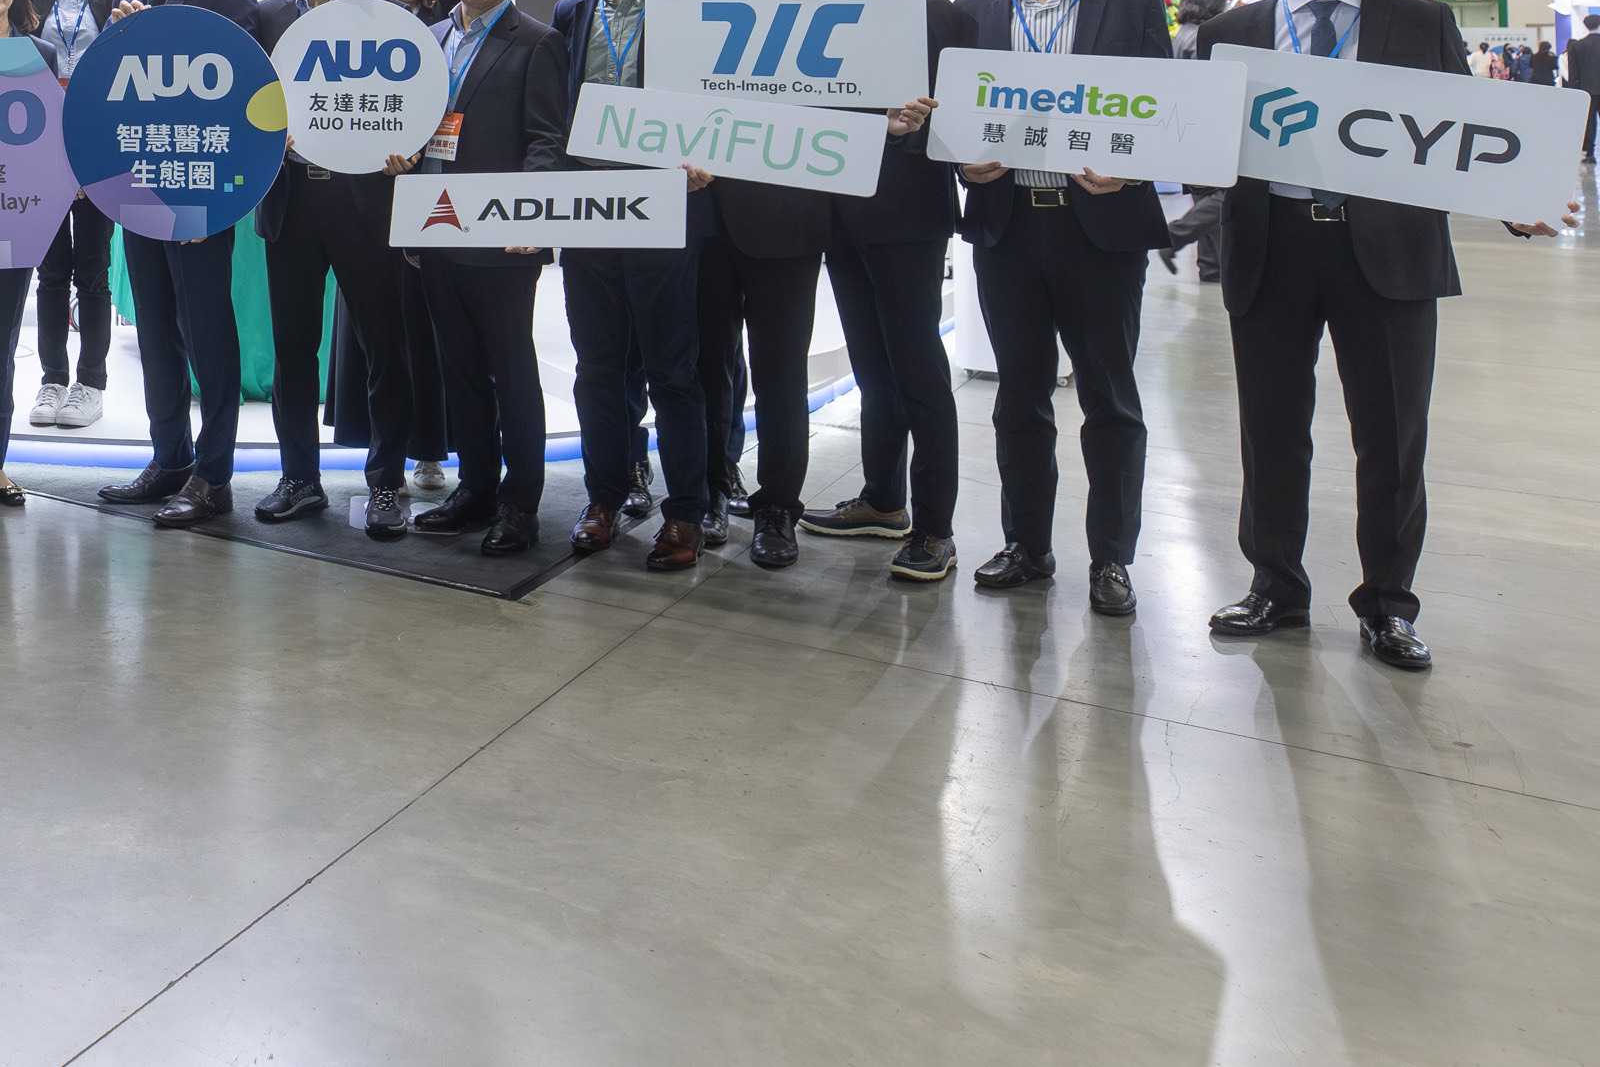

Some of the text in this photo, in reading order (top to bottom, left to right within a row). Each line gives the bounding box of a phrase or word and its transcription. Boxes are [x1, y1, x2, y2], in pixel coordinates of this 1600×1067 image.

[293, 38, 421, 82] AUO
[106, 52, 234, 102] AUO
[700, 79, 787, 95] Tech-Image
[792, 81, 822, 95] Co.,
[308, 92, 404, 113] 友達耘康
[975, 72, 1157, 119] imedtac
[116, 123, 231, 154] 智慧醫療
[308, 116, 404, 132] AUO Health
[982, 122, 1136, 155] 慧誠智醫
[596, 104, 849, 177] NaviFUS
[1338, 108, 1522, 173] CYP
[130, 159, 216, 191] 生態圈
[477, 196, 650, 221] ADLINK
